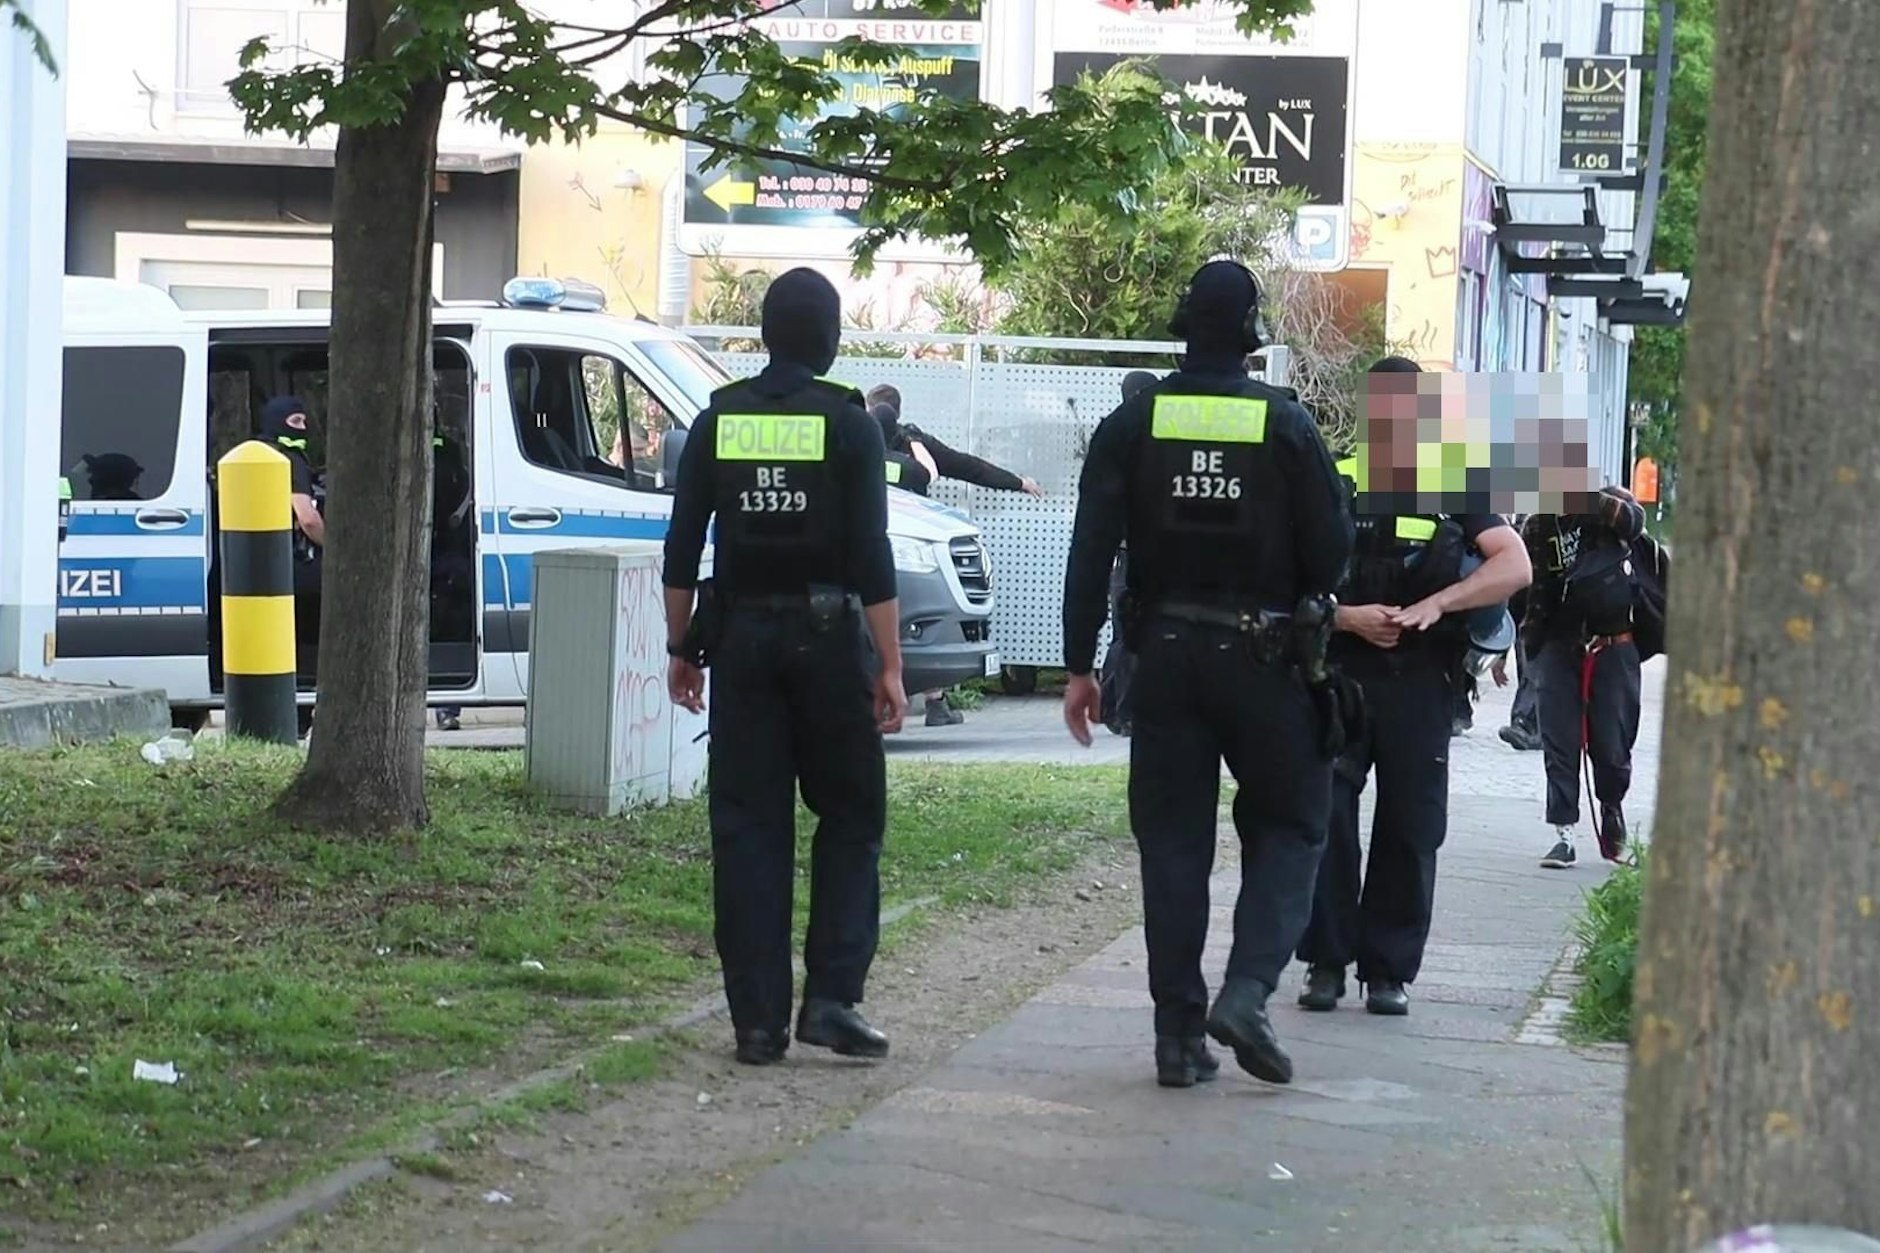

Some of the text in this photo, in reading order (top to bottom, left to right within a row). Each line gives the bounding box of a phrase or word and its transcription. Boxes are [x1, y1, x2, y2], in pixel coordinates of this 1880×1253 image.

[767, 22, 837, 38] AUTO
[857, 23, 973, 40] SERVICE
[899, 56, 955, 80] Auspuff
[1278, 99, 1312, 111] by LUX
[1170, 111, 1315, 161] TAN
[1229, 166, 1281, 185] NTER
[720, 418, 820, 456] POLIZEI
[1191, 450, 1223, 473] BE
[756, 466, 787, 488] BE
[1171, 475, 1242, 499] 13326
[739, 490, 808, 512] 13329
[60, 569, 121, 597] IZEI
